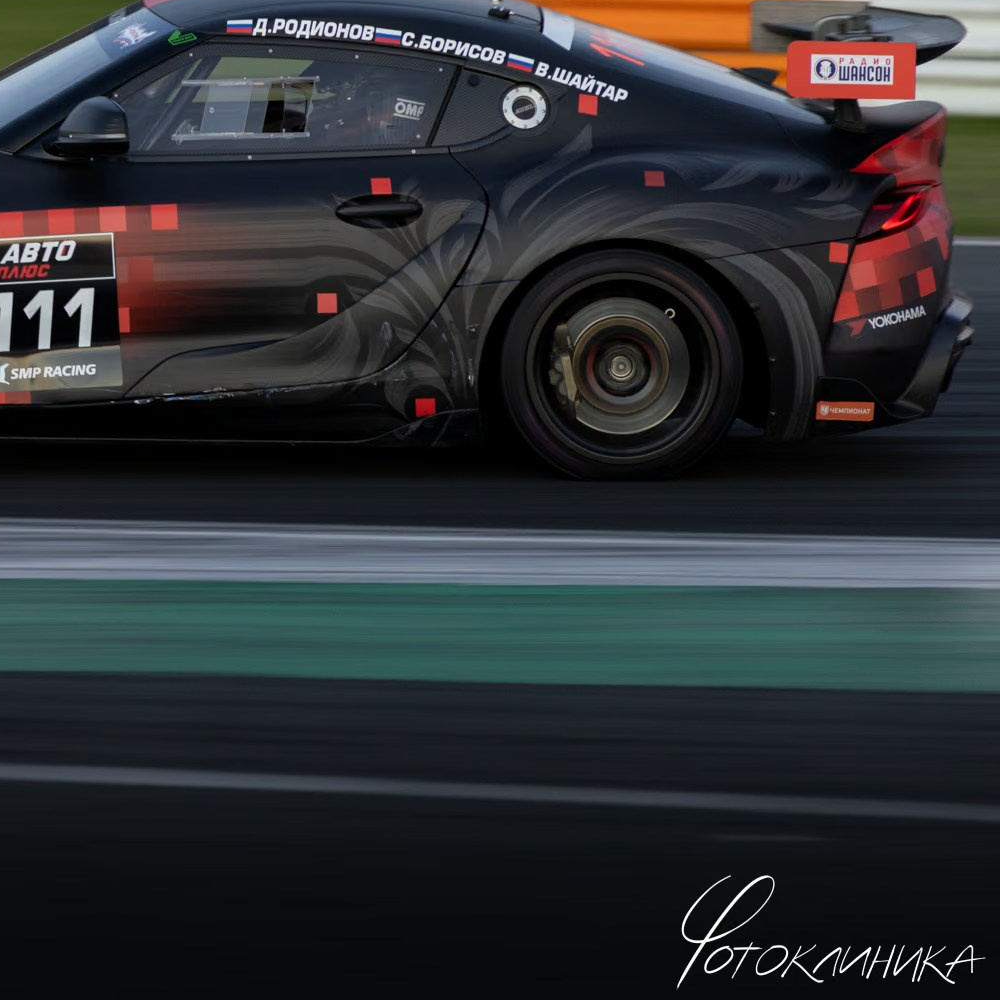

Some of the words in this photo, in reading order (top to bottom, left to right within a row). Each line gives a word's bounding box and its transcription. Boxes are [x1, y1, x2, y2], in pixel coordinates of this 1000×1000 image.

[252, 18, 375, 41] Д.РОДИОНОВ
[401, 31, 507, 65] С.БОРИСОВ
[534, 61, 629, 102] В.ШАЙТАР
[839, 57, 891, 66] РАДИО
[838, 65, 891, 82] ШАНСОН
[394, 101, 425, 118] OMP
[0, 240, 77, 265] АВТО
[867, 305, 927, 330] YOKOHAMA
[10, 367, 41, 380] SMP
[43, 363, 97, 378] RACING
[829, 407, 871, 415] ЧЕМПИОНАТ
